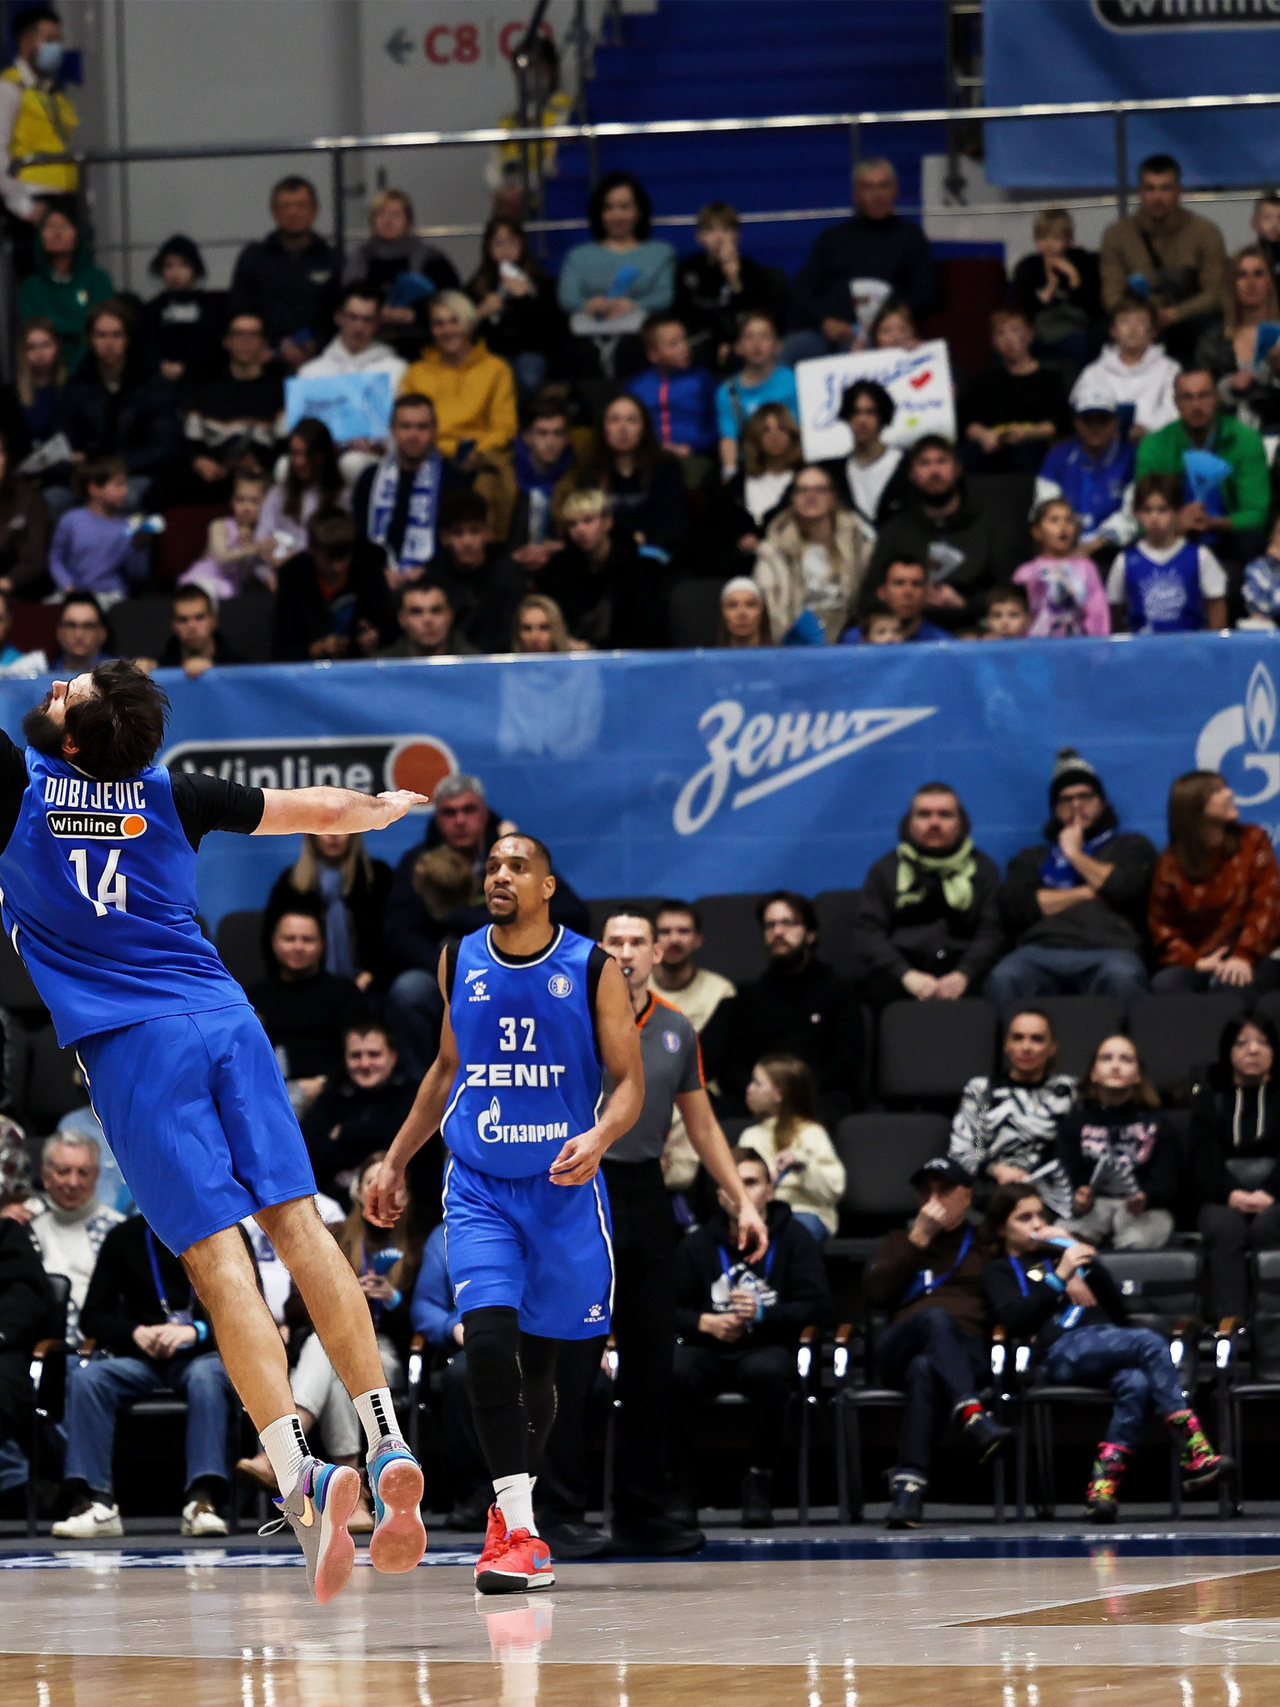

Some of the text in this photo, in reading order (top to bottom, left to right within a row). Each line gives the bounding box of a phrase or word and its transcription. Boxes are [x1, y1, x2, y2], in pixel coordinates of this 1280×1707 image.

[424, 23, 480, 66] C8
[44, 775, 147, 810] DUBLJEVIC
[50, 816, 117, 834] Winline
[68, 848, 127, 918] 14
[499, 1016, 537, 1052] 32
[466, 1064, 566, 1088] ZENIT
[503, 1121, 569, 1144] ГАЗПРОМ
